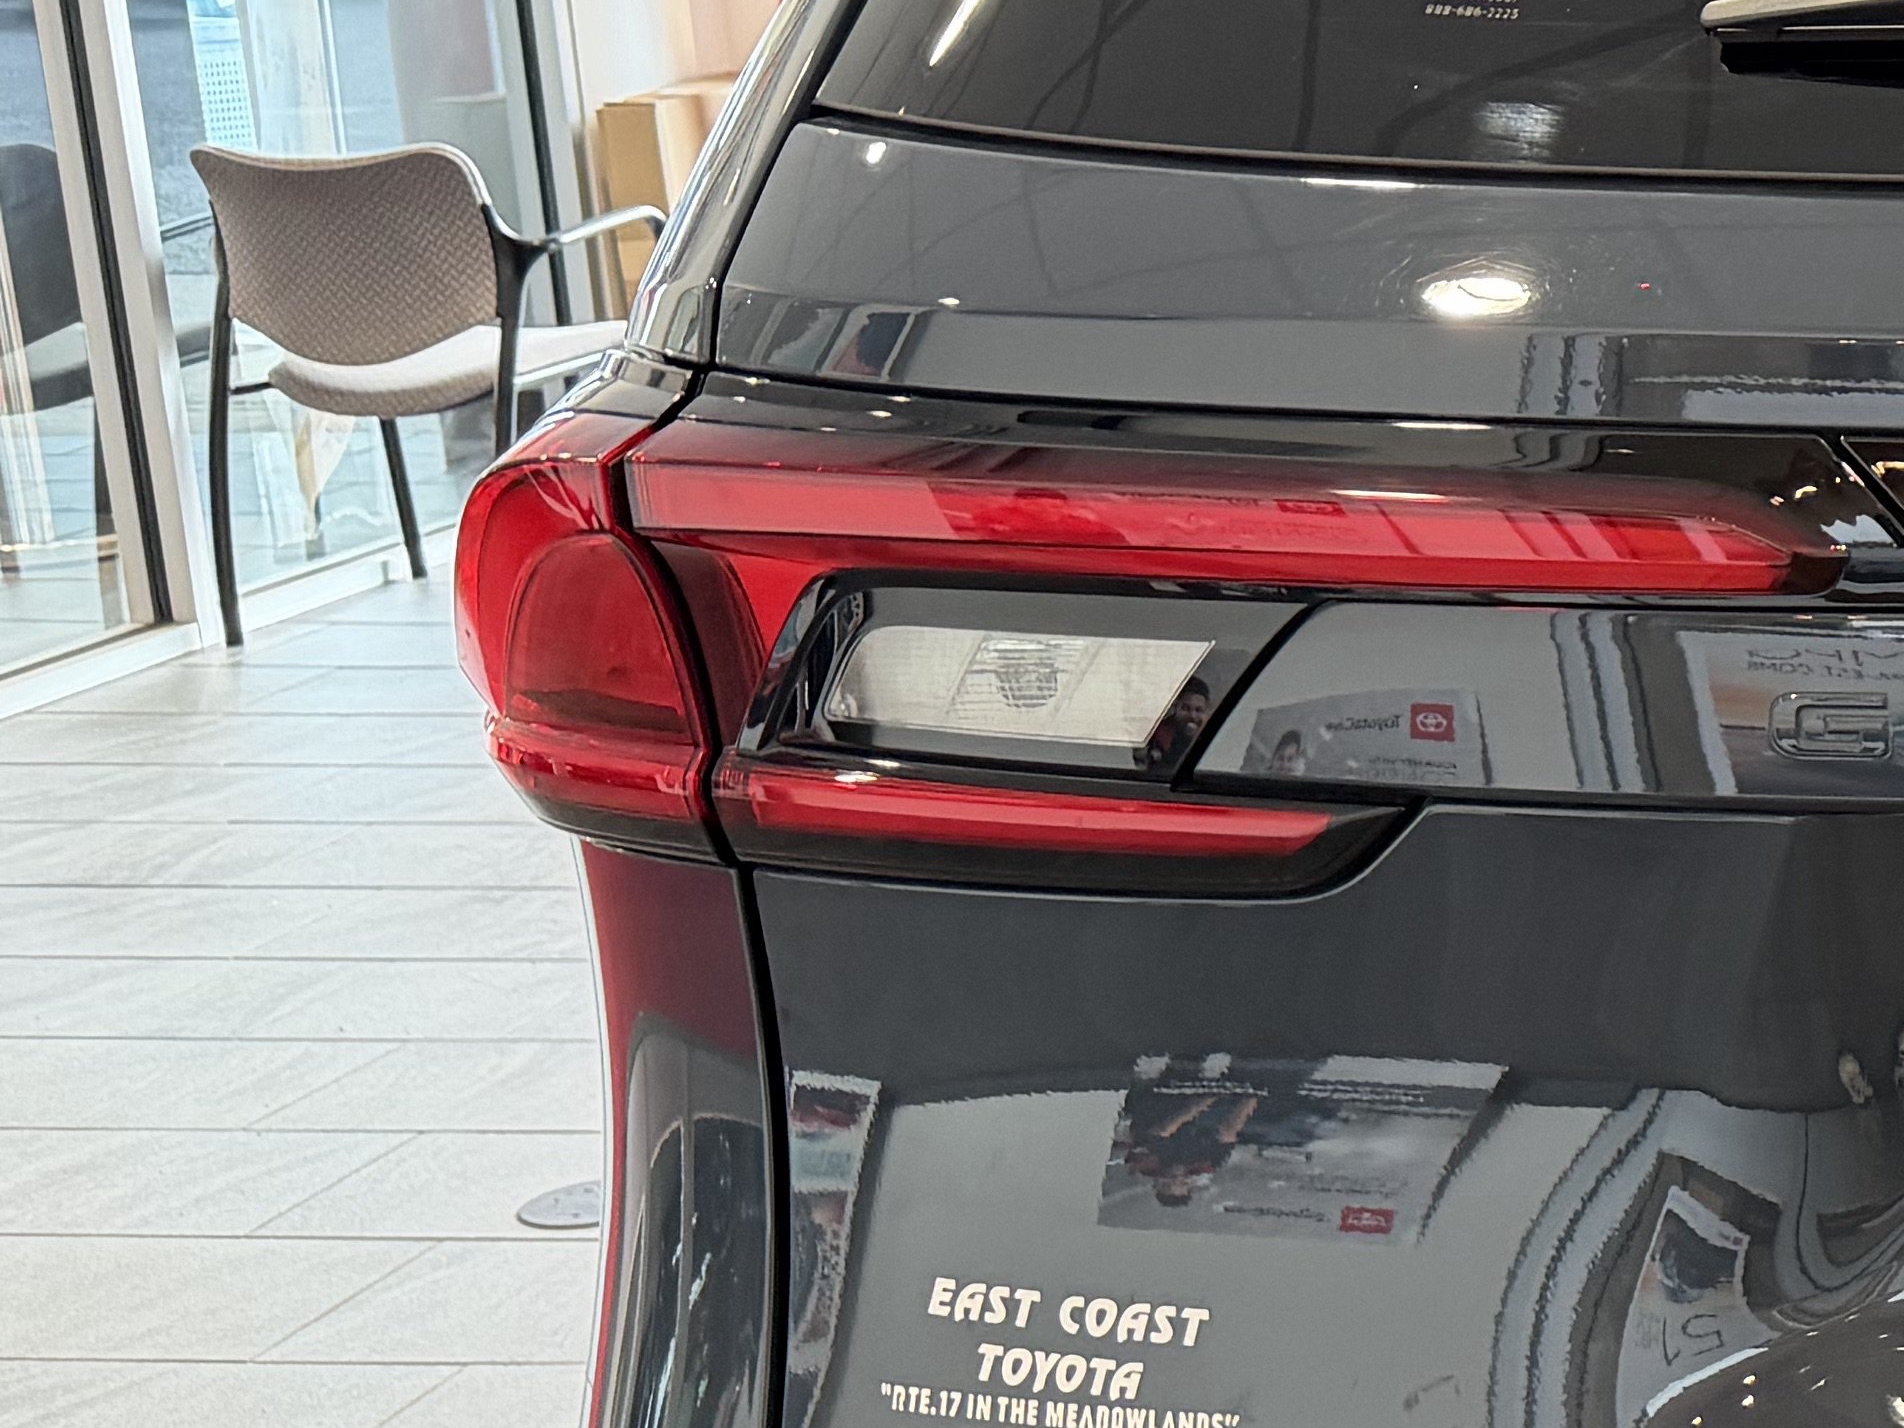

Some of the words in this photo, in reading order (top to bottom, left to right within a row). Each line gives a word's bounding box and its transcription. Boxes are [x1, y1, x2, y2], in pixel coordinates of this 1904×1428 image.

[928, 1276, 1041, 1329] EAST
[1059, 1294, 1211, 1348] COAST
[977, 1342, 1144, 1402] TOYOTA
[966, 1393, 992, 1422] IN
[997, 1395, 1039, 1428] THE
